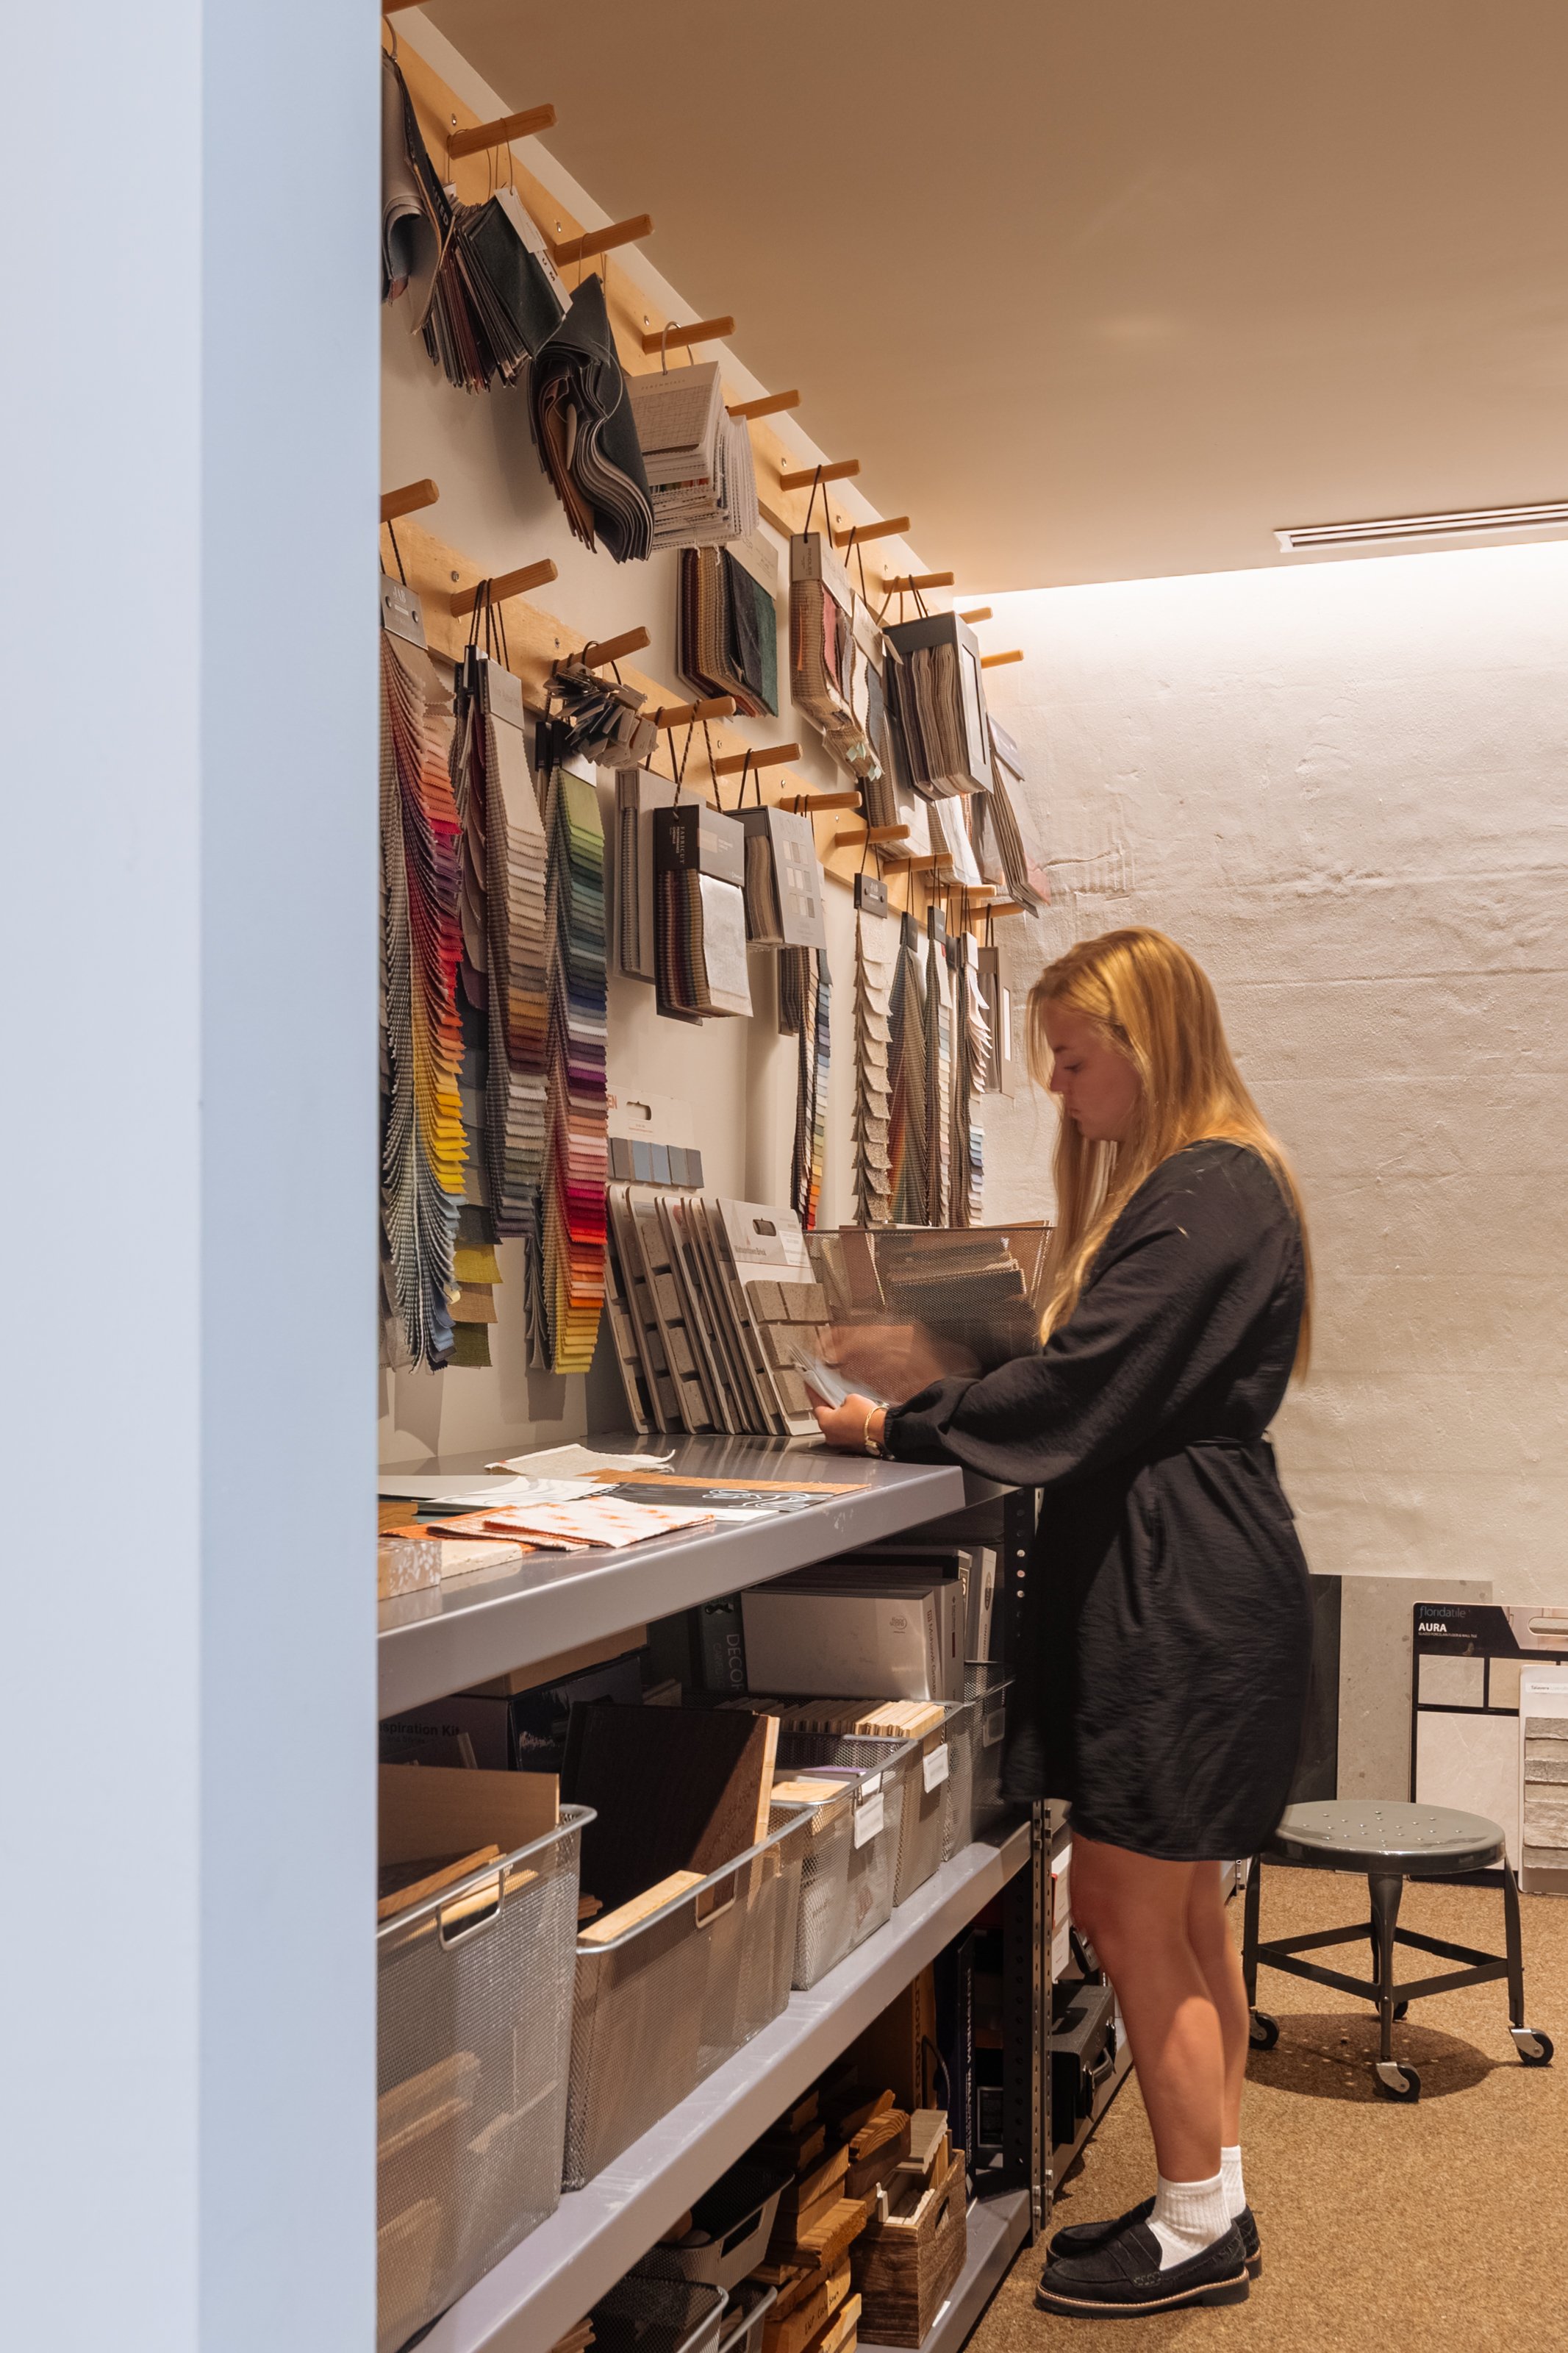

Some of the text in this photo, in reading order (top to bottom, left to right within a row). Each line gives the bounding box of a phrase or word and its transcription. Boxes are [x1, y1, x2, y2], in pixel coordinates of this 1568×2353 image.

[393, 585, 407, 604] JAB
[1419, 1605, 1467, 1619] floridatile
[1418, 1622, 1447, 1632] AURA
[443, 1725, 459, 1736] Kit
